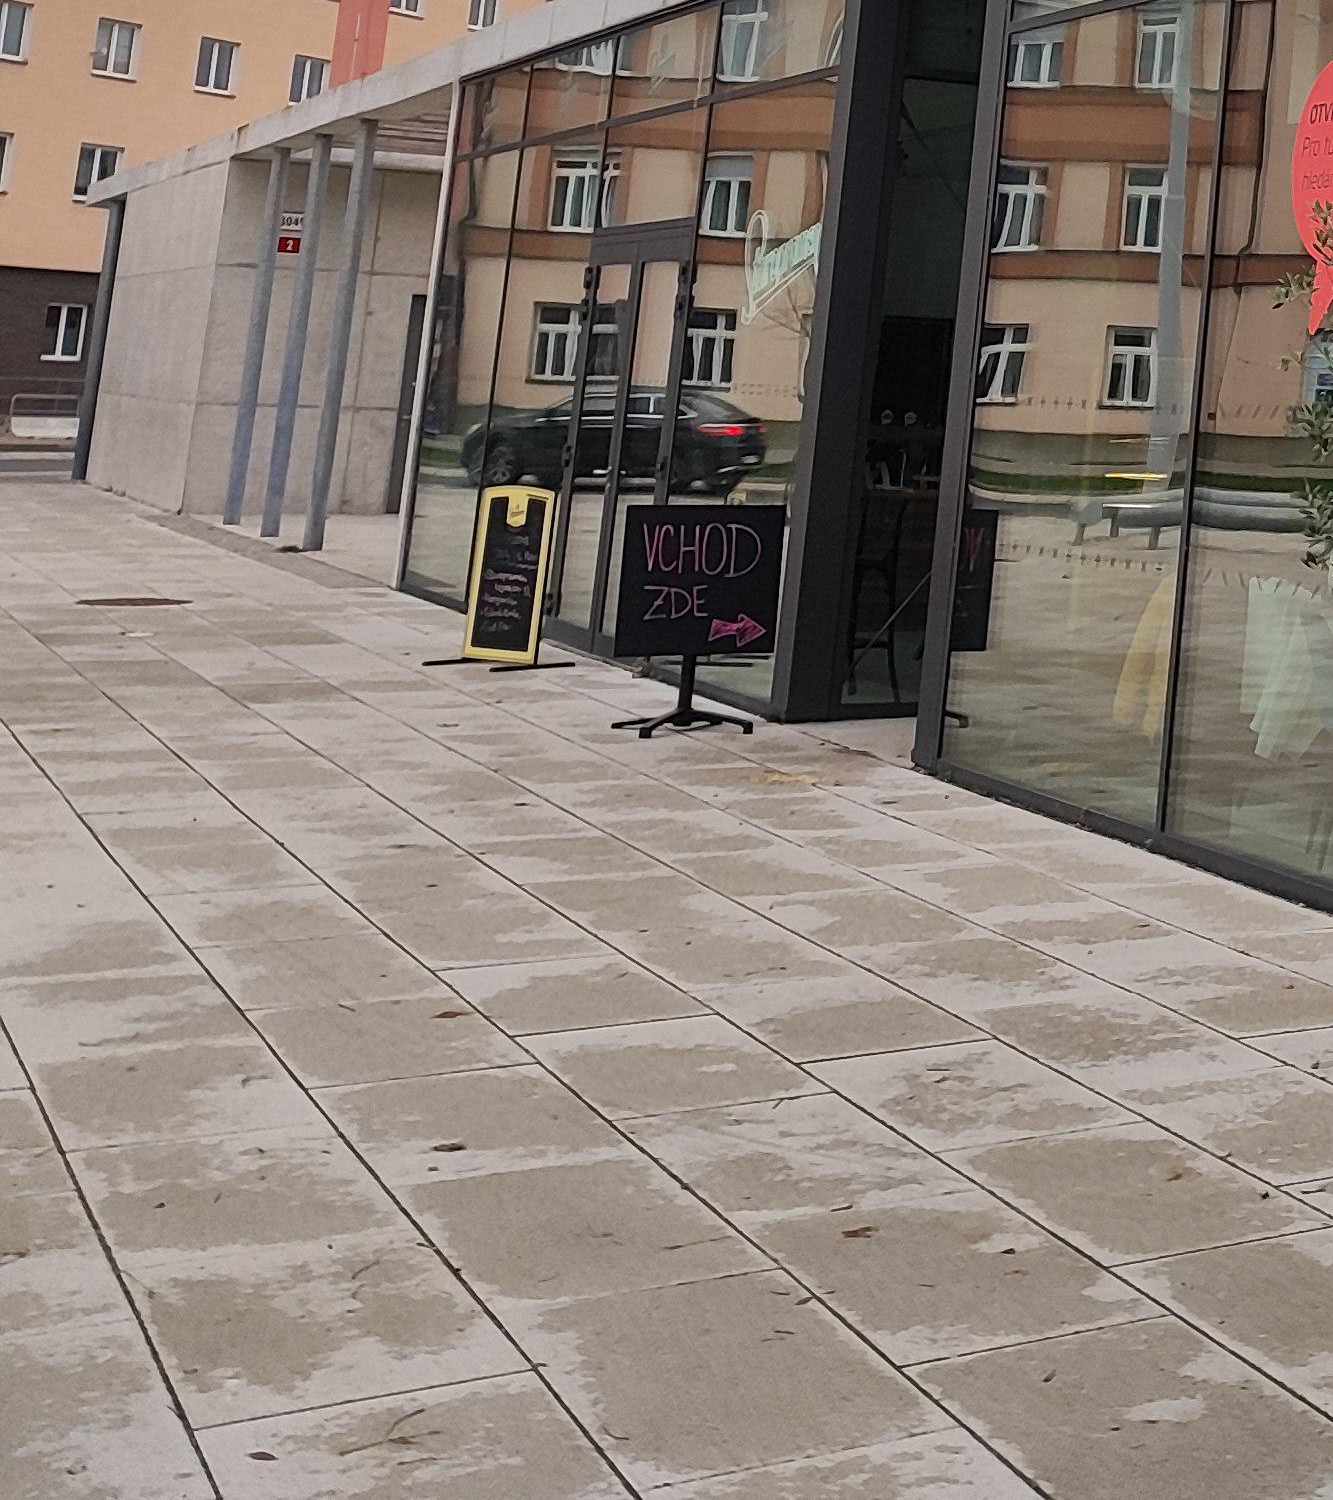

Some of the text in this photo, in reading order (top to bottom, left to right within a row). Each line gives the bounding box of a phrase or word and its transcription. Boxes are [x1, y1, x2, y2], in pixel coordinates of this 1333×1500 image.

[286, 239, 294, 251] 2
[642, 522, 762, 578] VCHOD
[642, 584, 710, 621] ZDE
